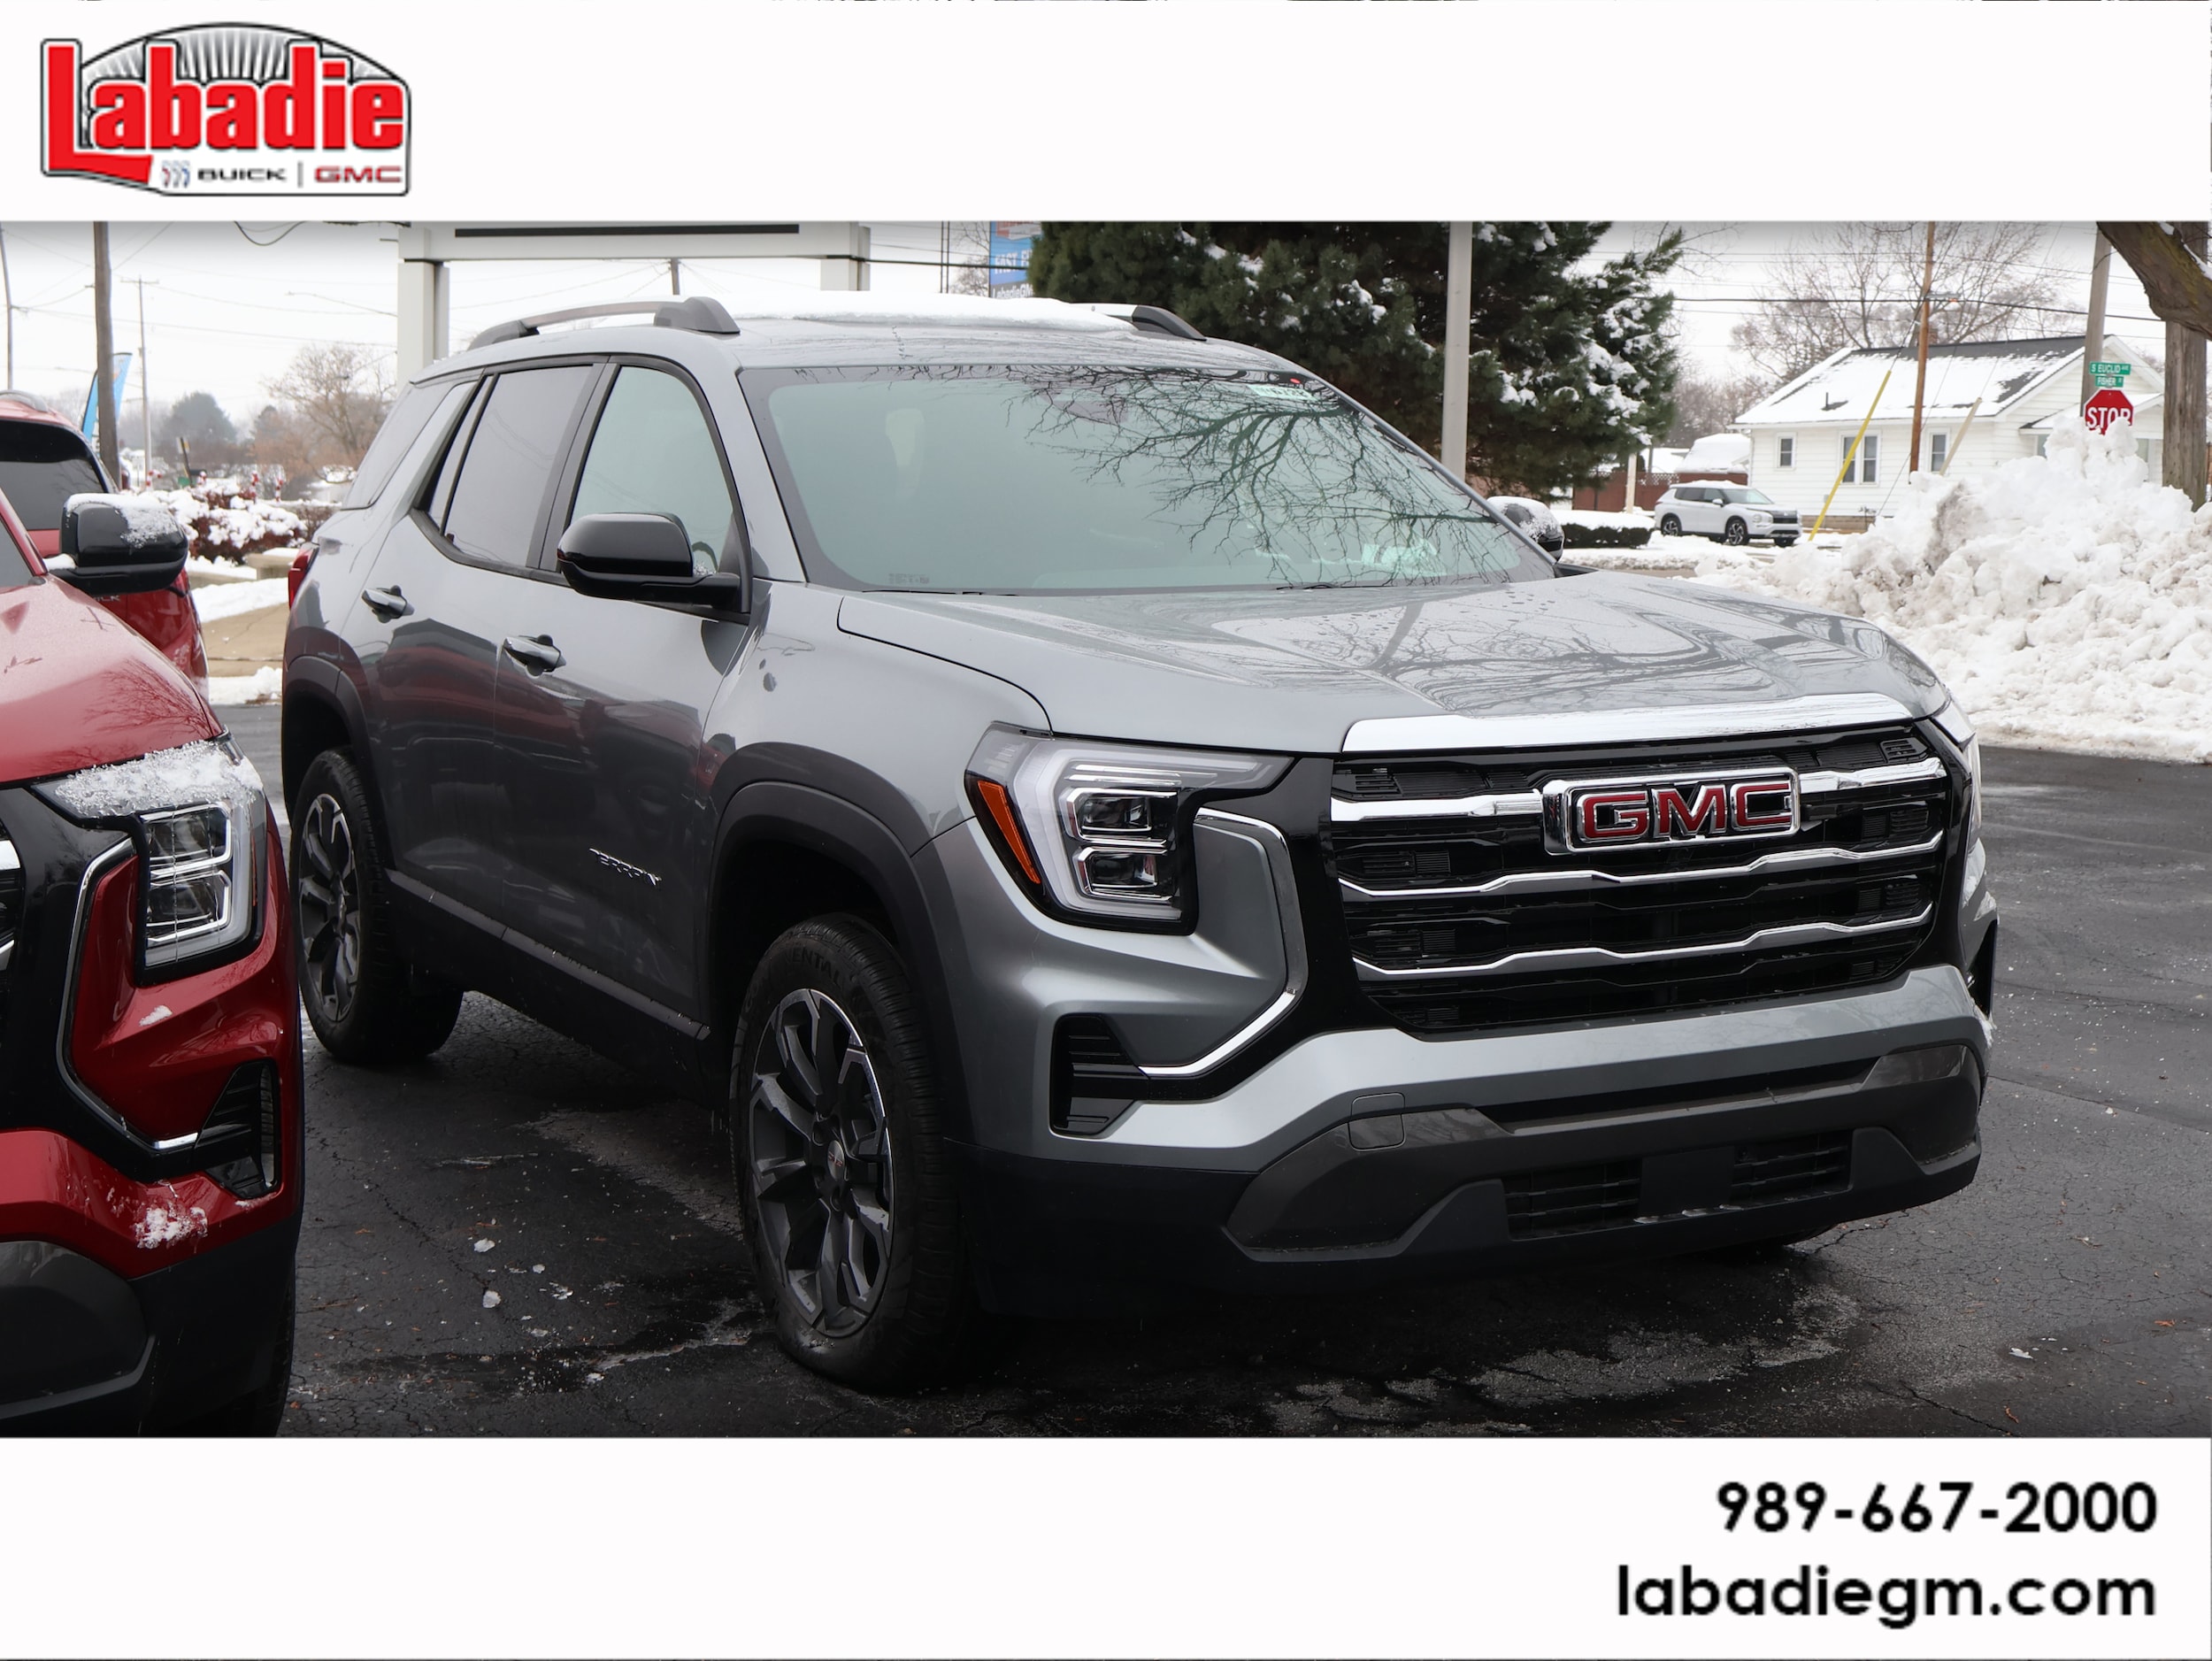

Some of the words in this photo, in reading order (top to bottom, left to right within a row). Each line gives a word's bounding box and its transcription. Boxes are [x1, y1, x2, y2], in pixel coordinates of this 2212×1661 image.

[2091, 363, 2097, 373] S
[2097, 364, 2121, 374] EUCLID
[2097, 376, 2116, 387] FISHER
[2086, 406, 2131, 430] STOP
[1577, 781, 1793, 843] GMC
